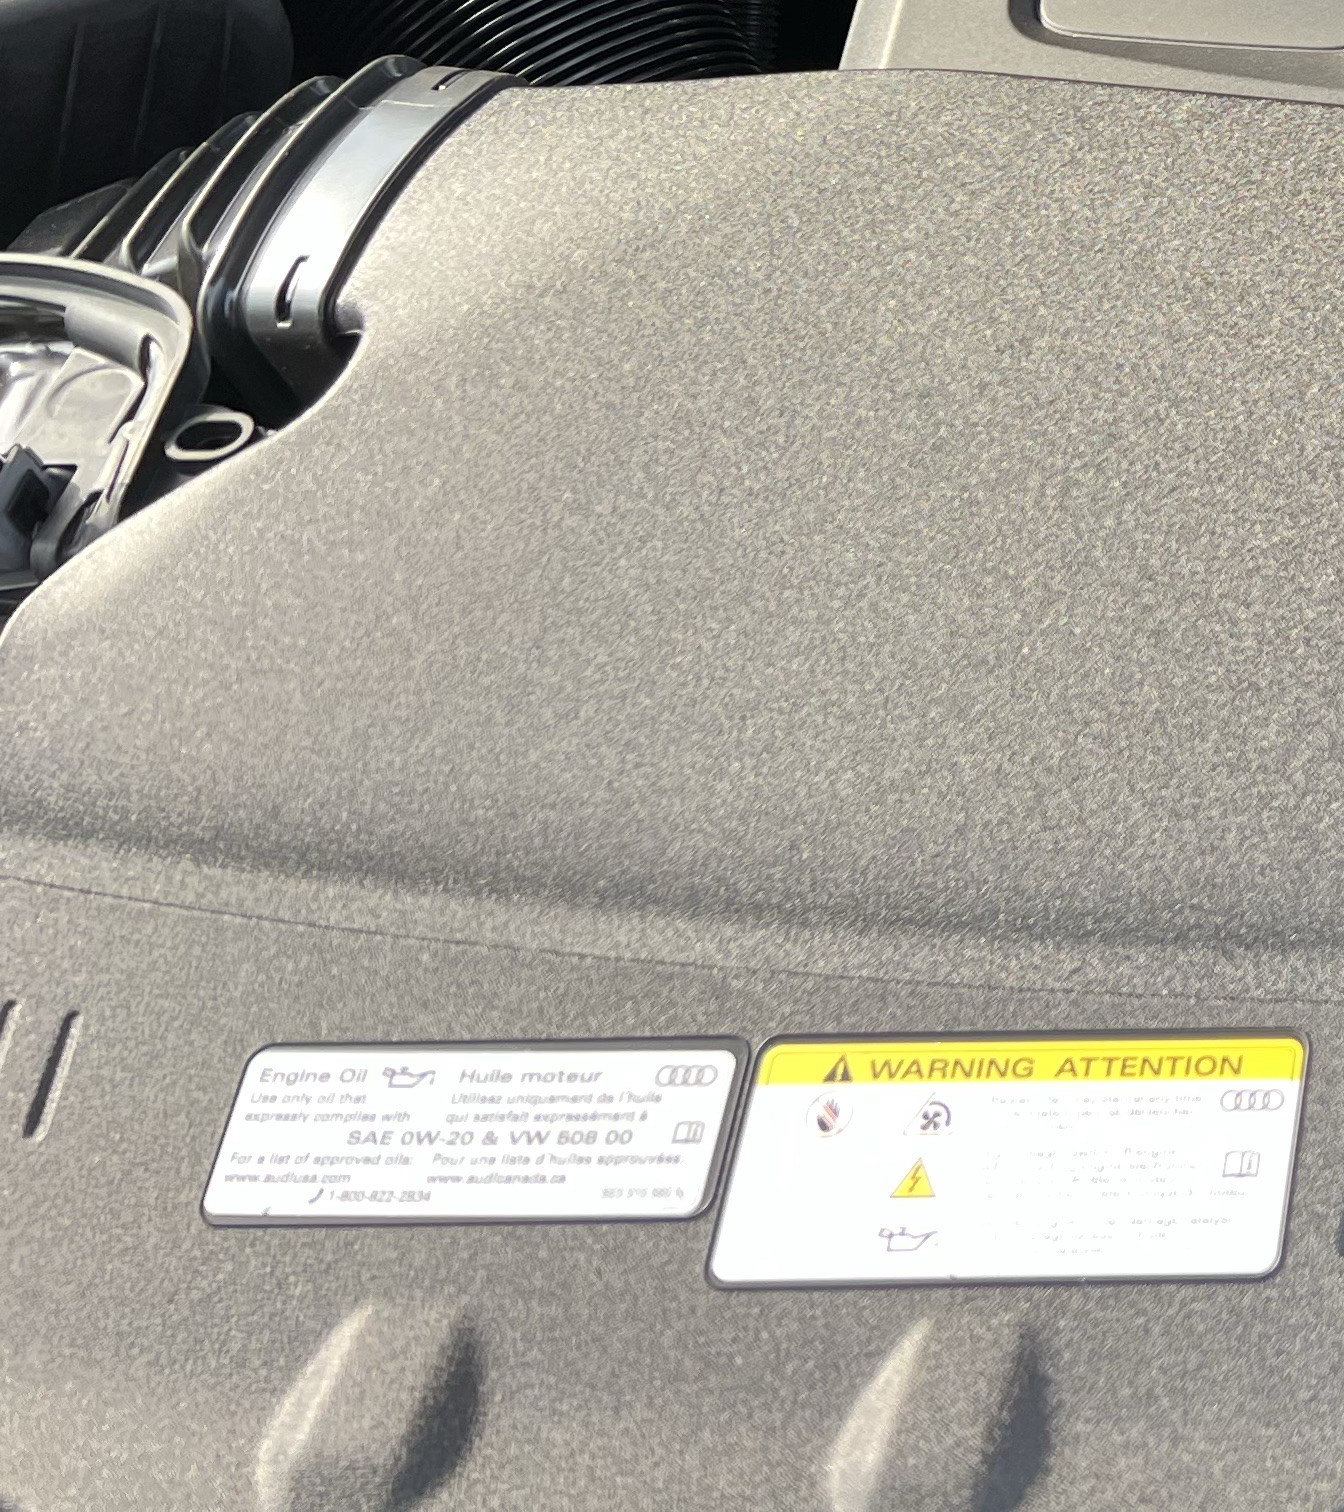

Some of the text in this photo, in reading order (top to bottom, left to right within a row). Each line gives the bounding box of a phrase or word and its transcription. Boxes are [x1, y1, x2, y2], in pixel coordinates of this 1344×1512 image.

[870, 1054, 1244, 1080] WARNING ATTENTION
[259, 1067, 368, 1086] Engine Oil
[459, 1068, 603, 1084] Huile moteur
[346, 1130, 394, 1146] SAE
[400, 1130, 475, 1146] 0W-20
[481, 1130, 499, 1146] &
[509, 1130, 551, 1145] VW
[605, 1130, 634, 1145] 00
